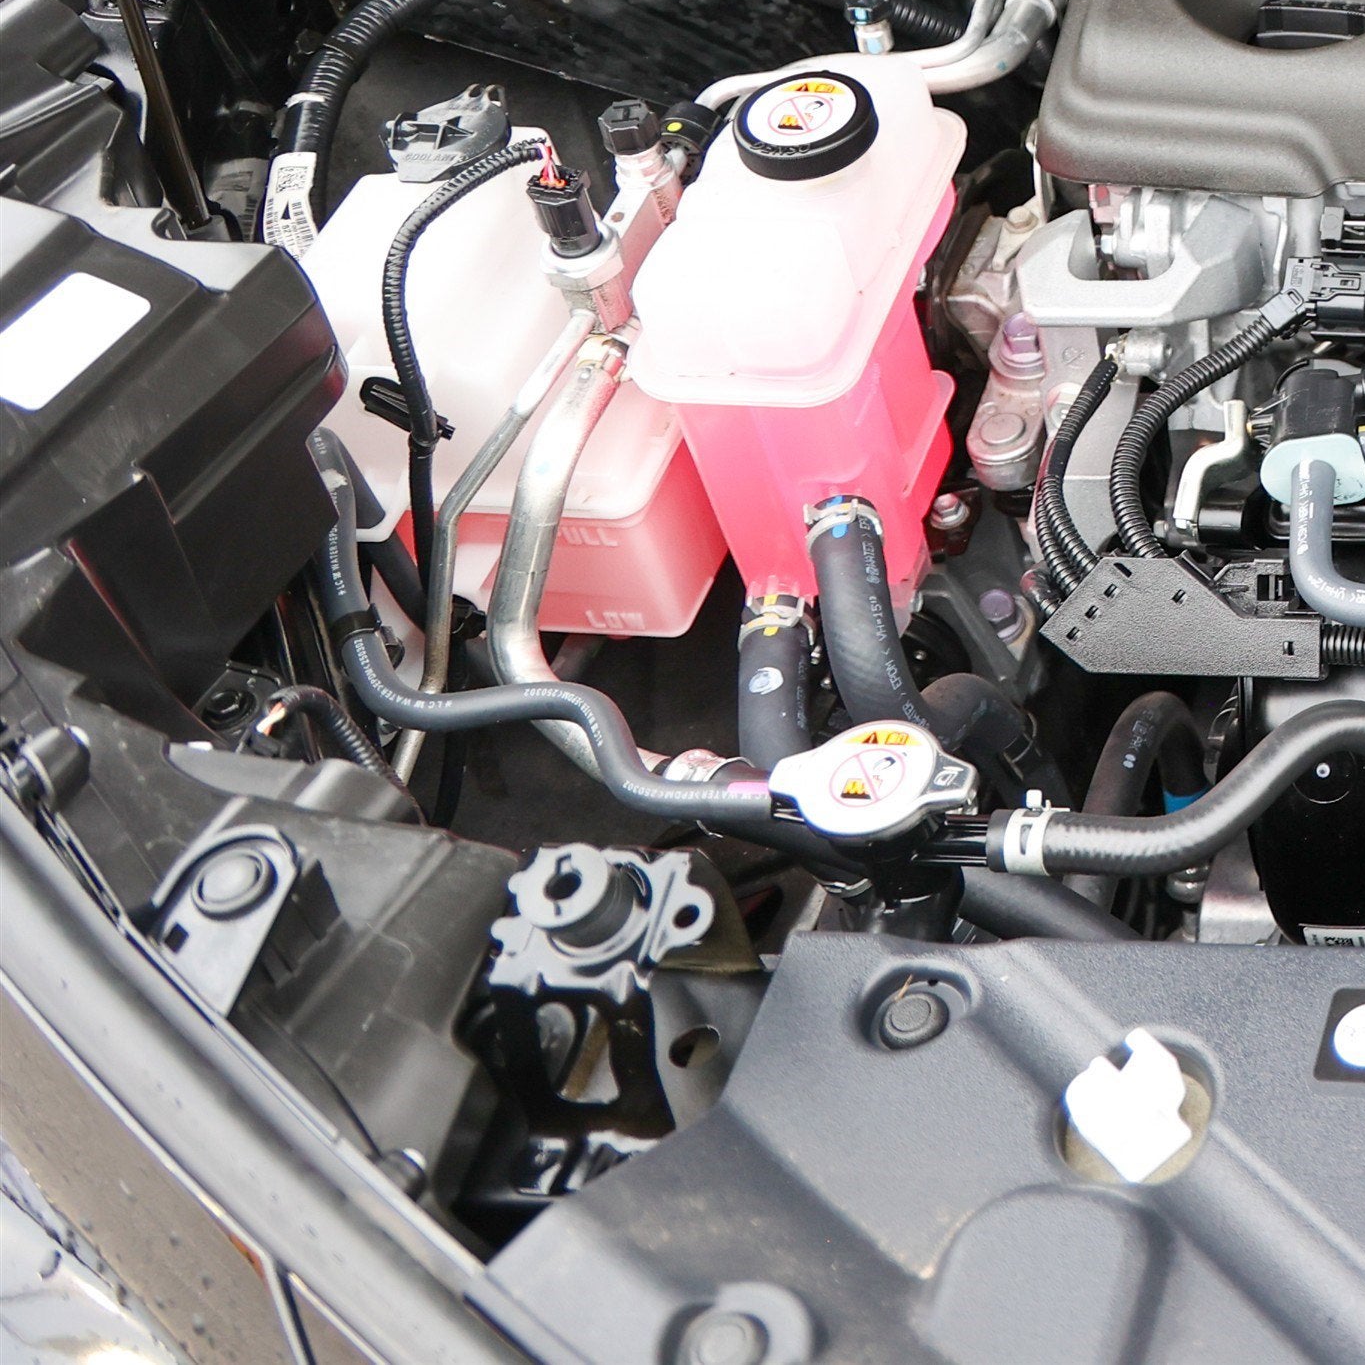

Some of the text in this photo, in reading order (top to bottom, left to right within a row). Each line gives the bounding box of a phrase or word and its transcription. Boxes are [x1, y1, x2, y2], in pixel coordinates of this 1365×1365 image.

[751, 143, 811, 156] DENSO
[556, 527, 619, 547] ULL
[585, 609, 645, 631] LOW
